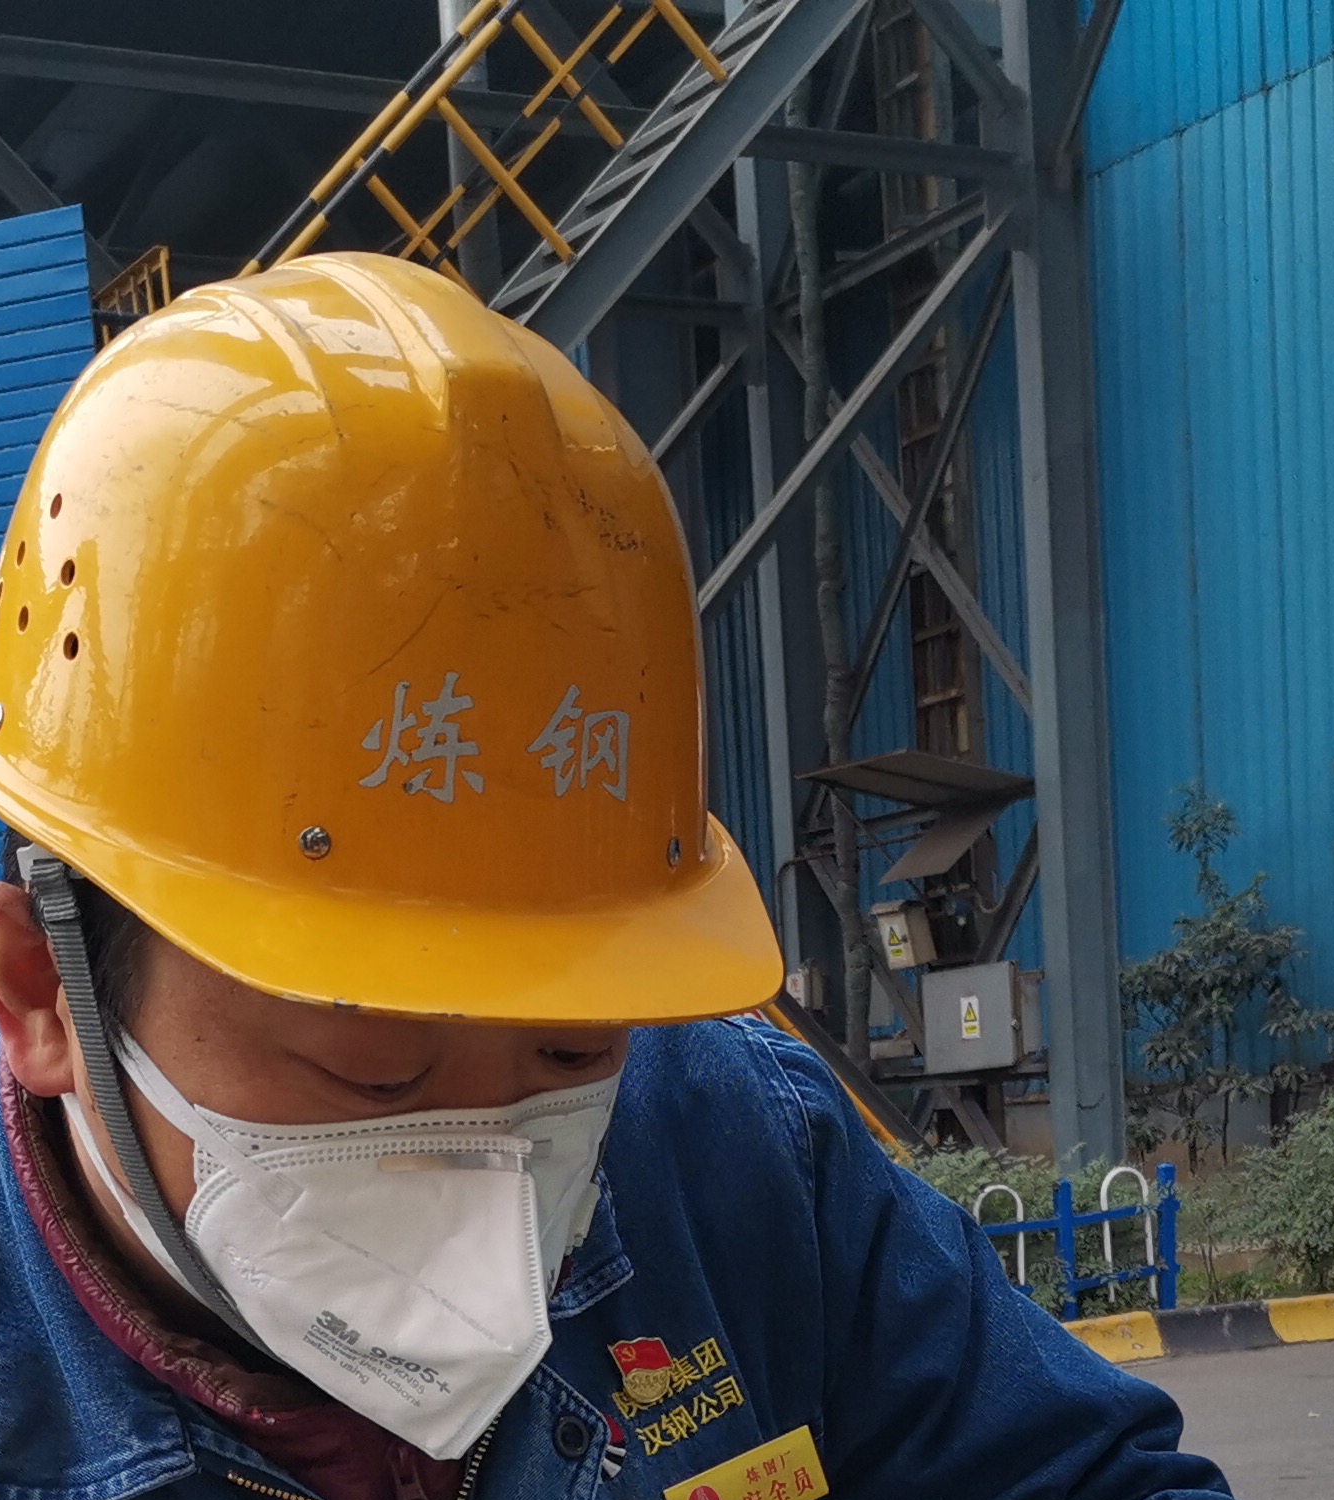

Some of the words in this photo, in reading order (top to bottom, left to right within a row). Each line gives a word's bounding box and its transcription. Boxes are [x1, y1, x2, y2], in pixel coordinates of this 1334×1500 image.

[357, 671, 630, 803] 炼钢
[316, 1310, 361, 1346] 3M
[370, 1346, 451, 1394] 9505+
[340, 1361, 370, 1385] using
[635, 1375, 745, 1456] 汉钢公司
